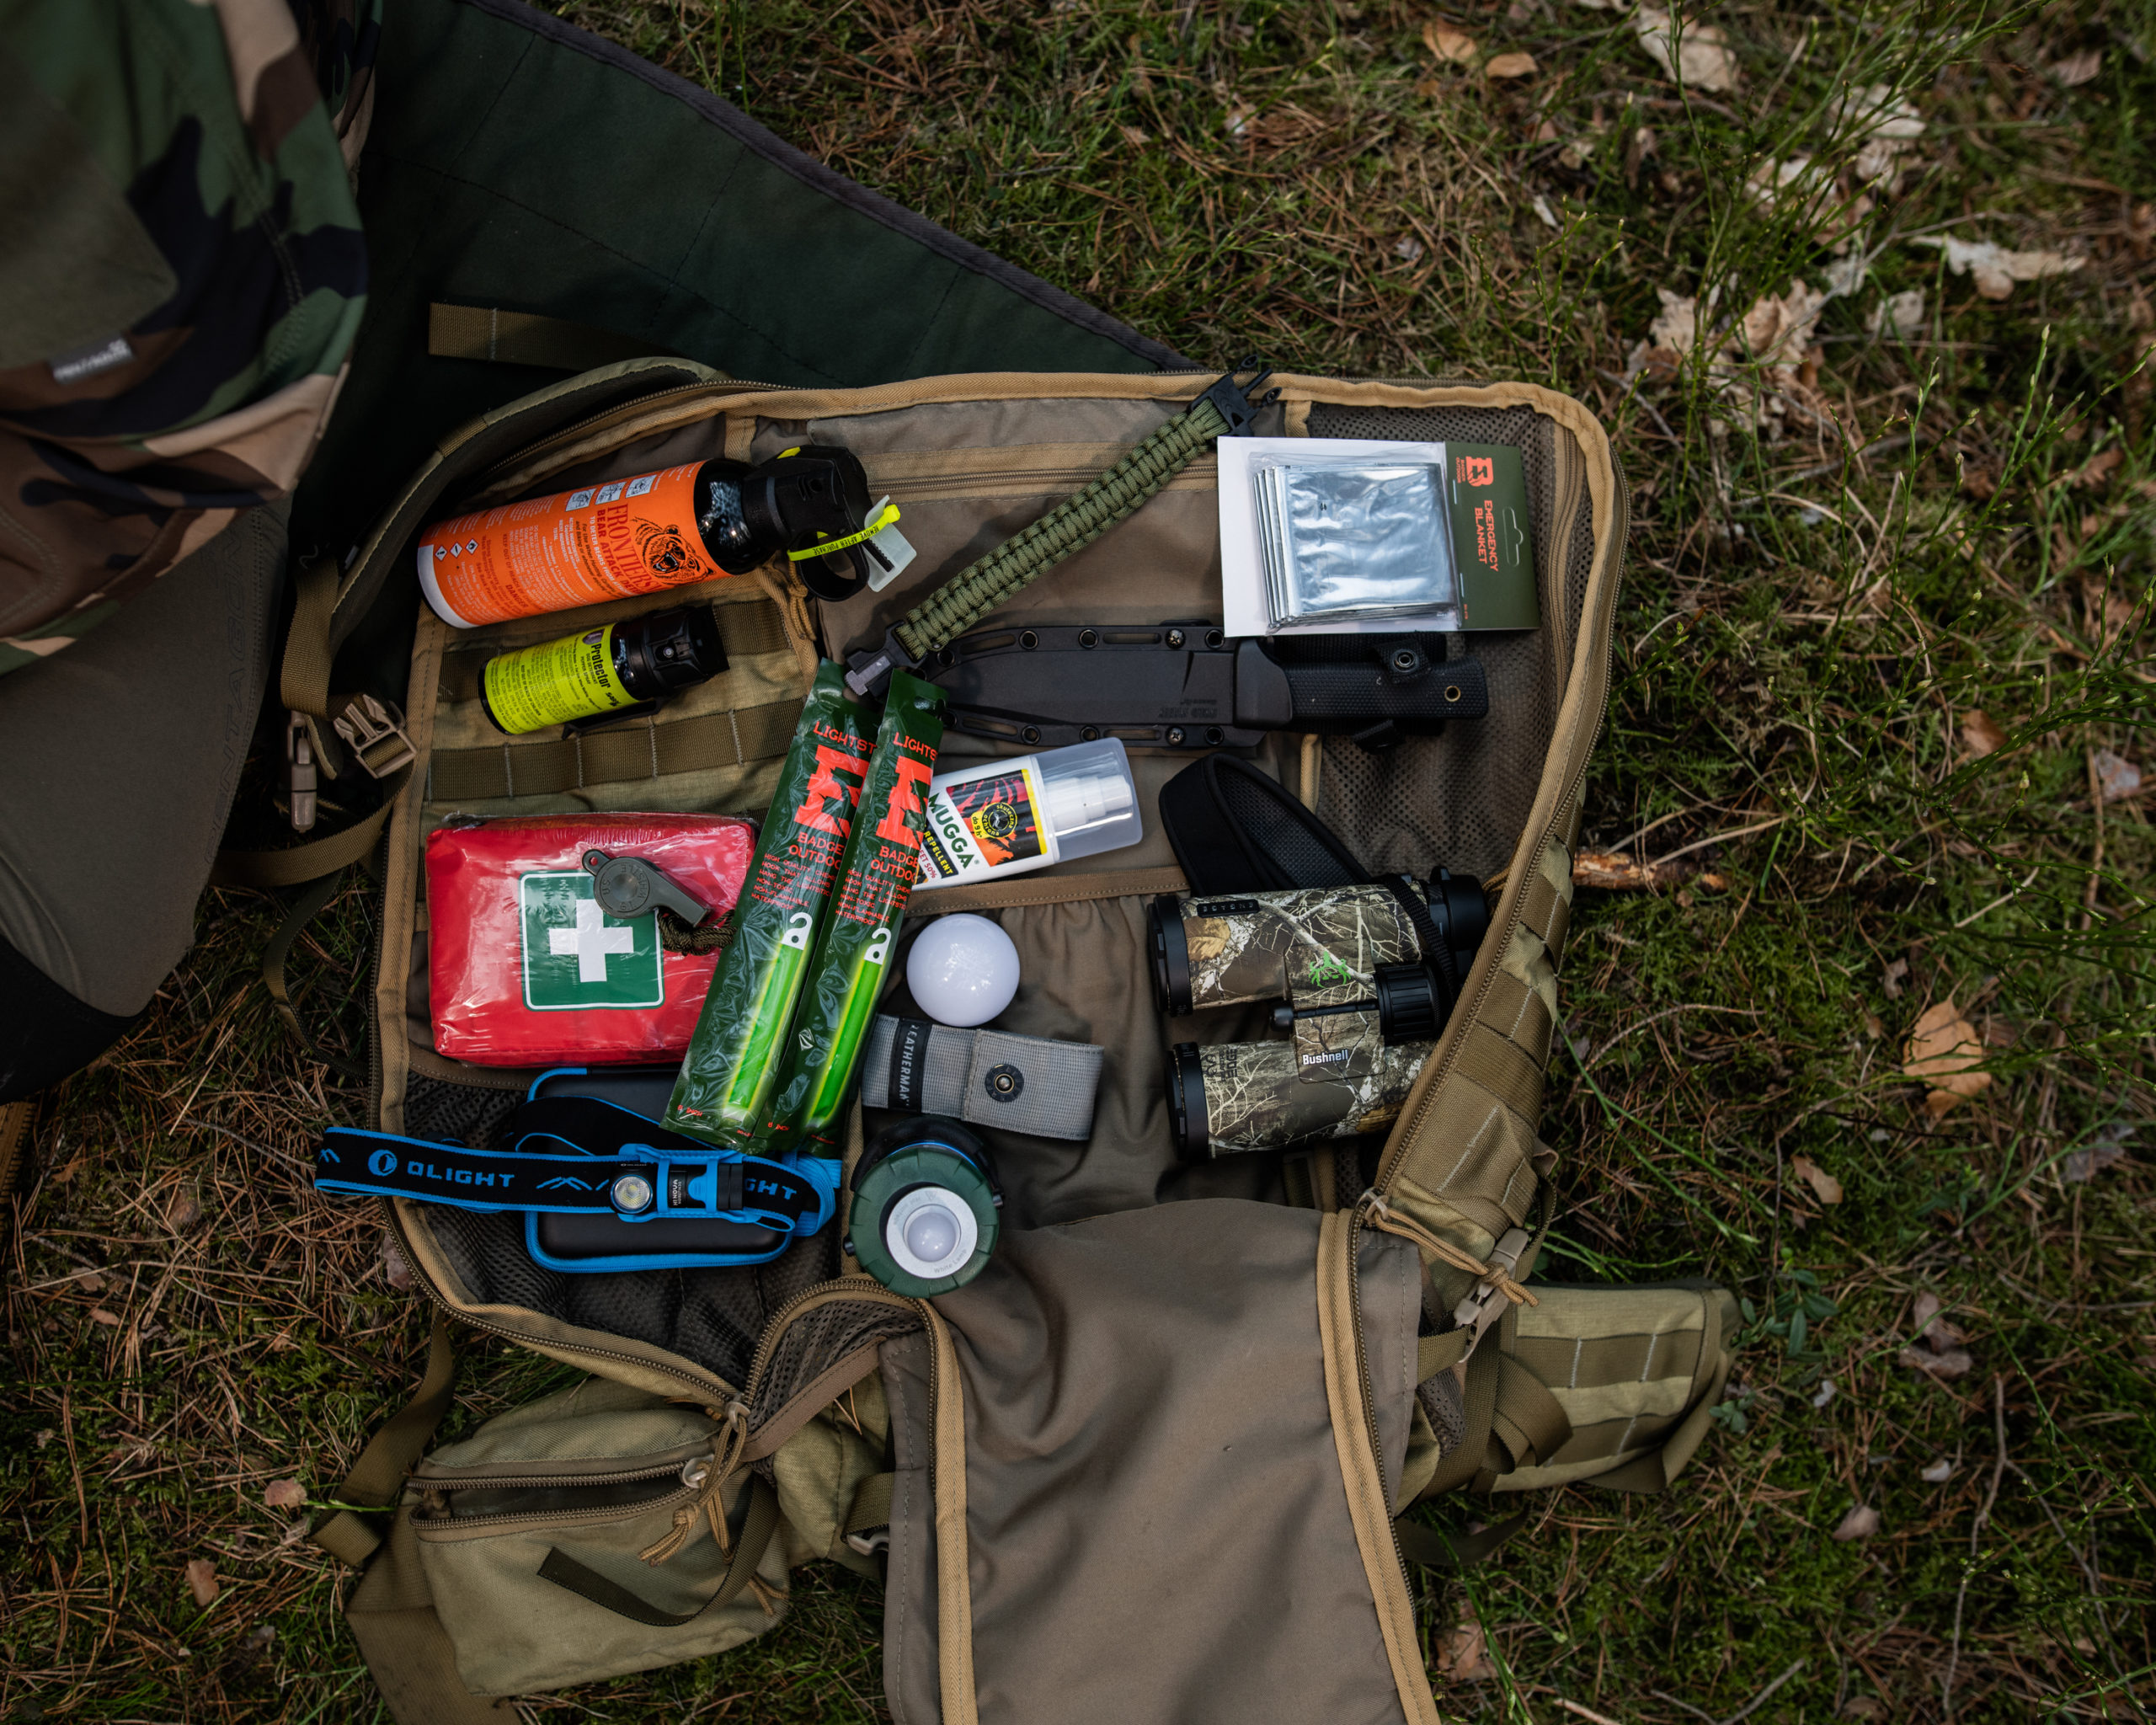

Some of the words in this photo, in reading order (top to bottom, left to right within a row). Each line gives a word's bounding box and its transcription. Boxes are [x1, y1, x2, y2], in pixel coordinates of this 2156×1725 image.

[590, 515, 595, 524] TO
[596, 509, 606, 537] BEAR
[589, 526, 597, 544] DETER
[839, 536, 857, 547] AFTER
[859, 525, 879, 540] REMOVE
[1474, 507, 1487, 563] BLANKET
[1484, 499, 1498, 571] EMERGENCY
[584, 544, 593, 558] When
[593, 547, 605, 565] BEARS
[813, 542, 838, 555] PURCHASE
[600, 542, 623, 577] ATTACK
[601, 566, 615, 580] FROM
[504, 584, 528, 607] DANGER
[590, 643, 611, 687] Protector
[813, 720, 878, 754] LIGHTST
[973, 816, 979, 825] do
[983, 814, 1000, 836] ochrona
[996, 804, 1014, 829] skuteczna
[797, 830, 845, 855] BADGE
[923, 830, 953, 875] REPELLENT
[761, 861, 780, 871] HOOK
[783, 868, 800, 879] THAT
[764, 852, 780, 862] HIGH
[782, 859, 810, 873] QUALITY
[924, 862, 937, 879] 50%
[620, 862, 648, 900] WHISTLE
[759, 868, 776, 879] HANG
[780, 876, 792, 884] THE
[845, 877, 862, 886] HOOK
[865, 883, 883, 893] THAT
[847, 868, 862, 878] HIGH
[864, 874, 893, 888] QUALITY
[842, 884, 859, 895] HANG
[862, 891, 876, 900] THE
[750, 893, 794, 911] WATERPROOF
[835, 909, 876, 926] WATERPROOF
[1302, 1049, 1348, 1065] Bushnell
[407, 1161, 515, 1188] OLIGHT
[932, 1263, 952, 1273] White
